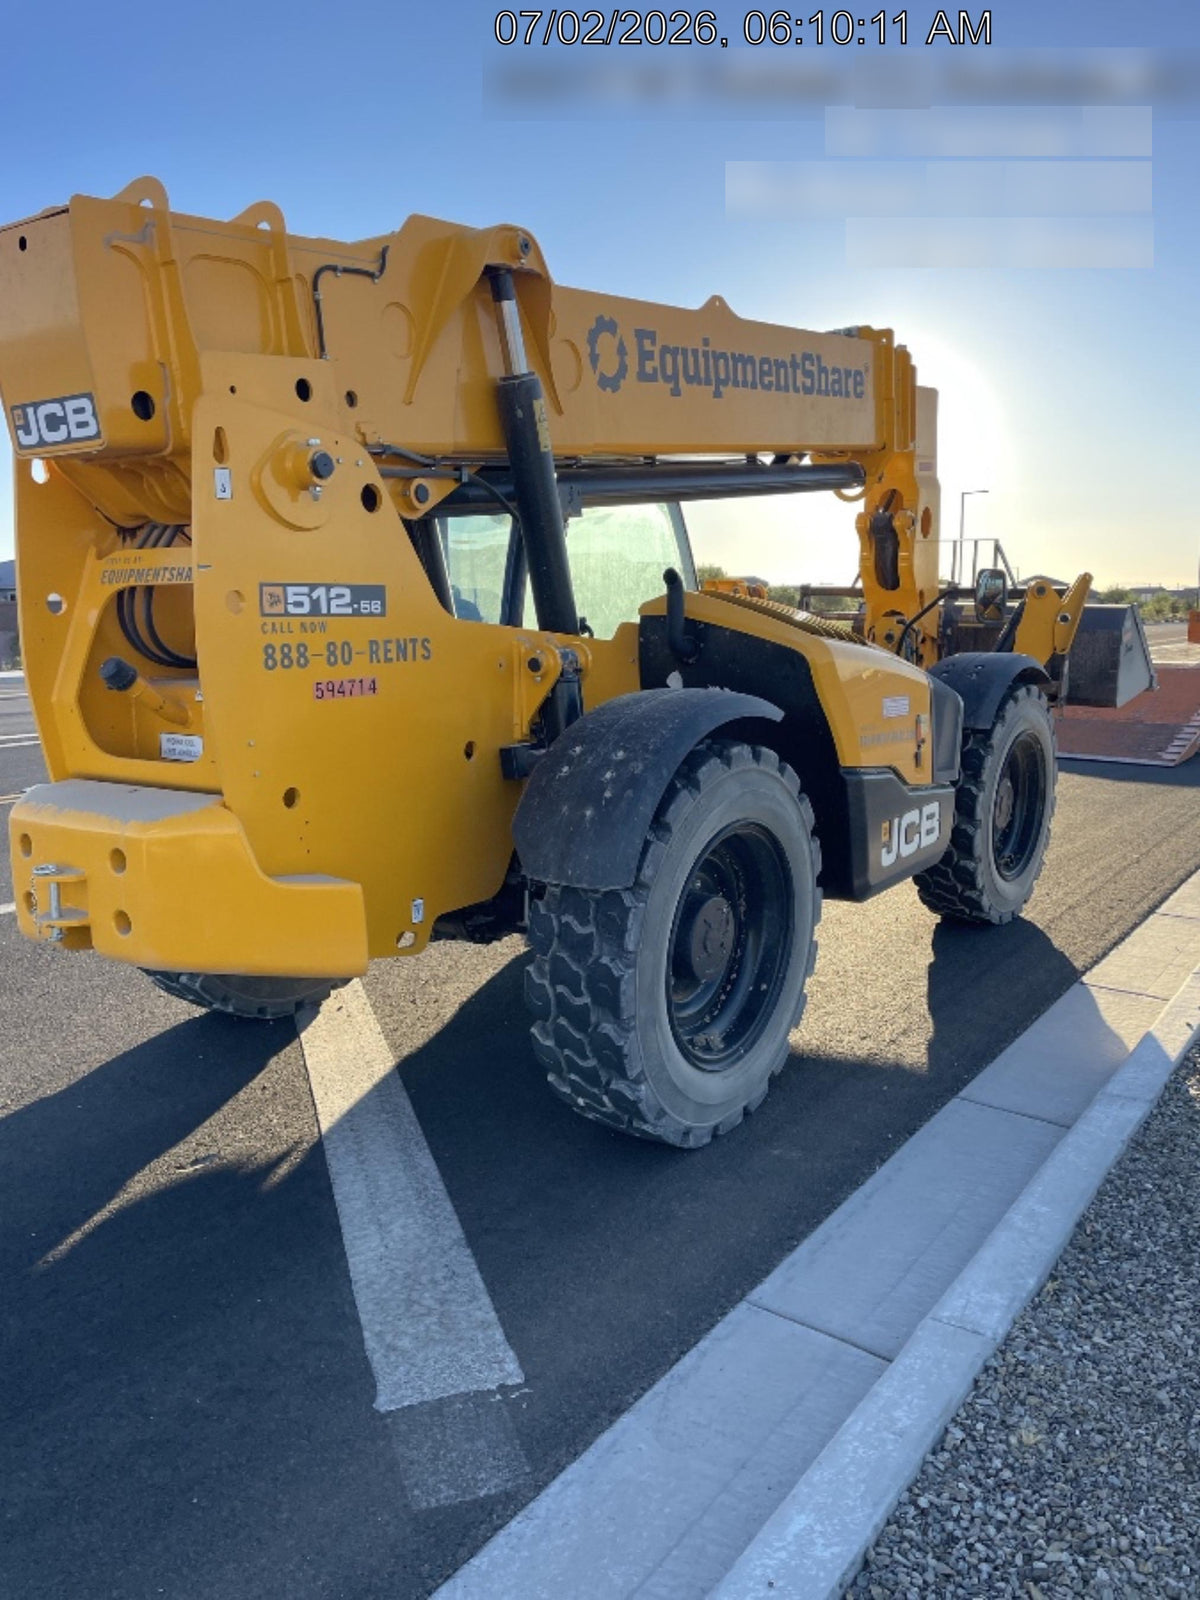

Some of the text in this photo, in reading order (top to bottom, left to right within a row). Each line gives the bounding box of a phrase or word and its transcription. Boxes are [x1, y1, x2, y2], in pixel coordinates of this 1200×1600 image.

[634, 328, 864, 399] EquipmentShare
[17, 397, 98, 445] JCB
[261, 621, 328, 634] CALL NOW
[263, 638, 432, 671] 888-80-RENTS
[315, 677, 378, 700] 594714
[881, 801, 940, 867] JCB
